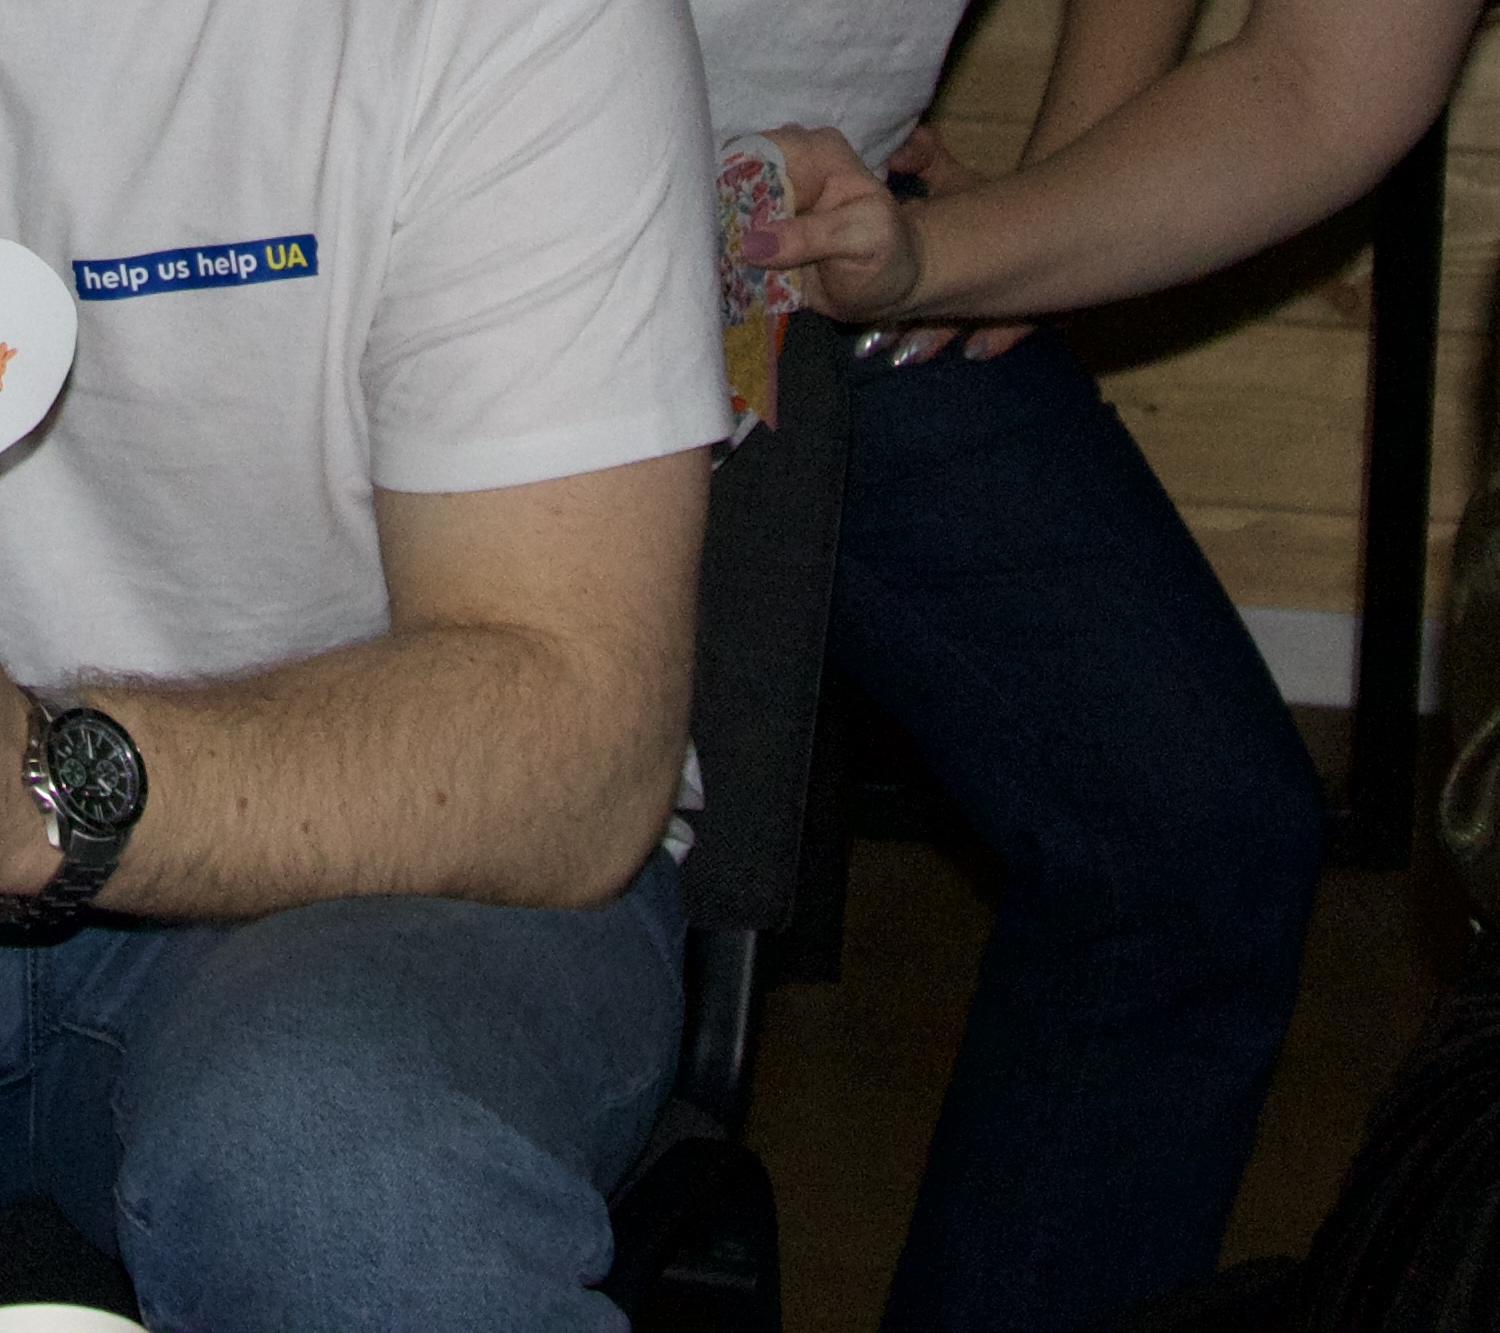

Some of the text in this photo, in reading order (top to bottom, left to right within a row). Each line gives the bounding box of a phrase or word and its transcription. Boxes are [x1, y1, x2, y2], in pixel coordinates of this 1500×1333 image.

[83, 243, 308, 292] help us help UA
